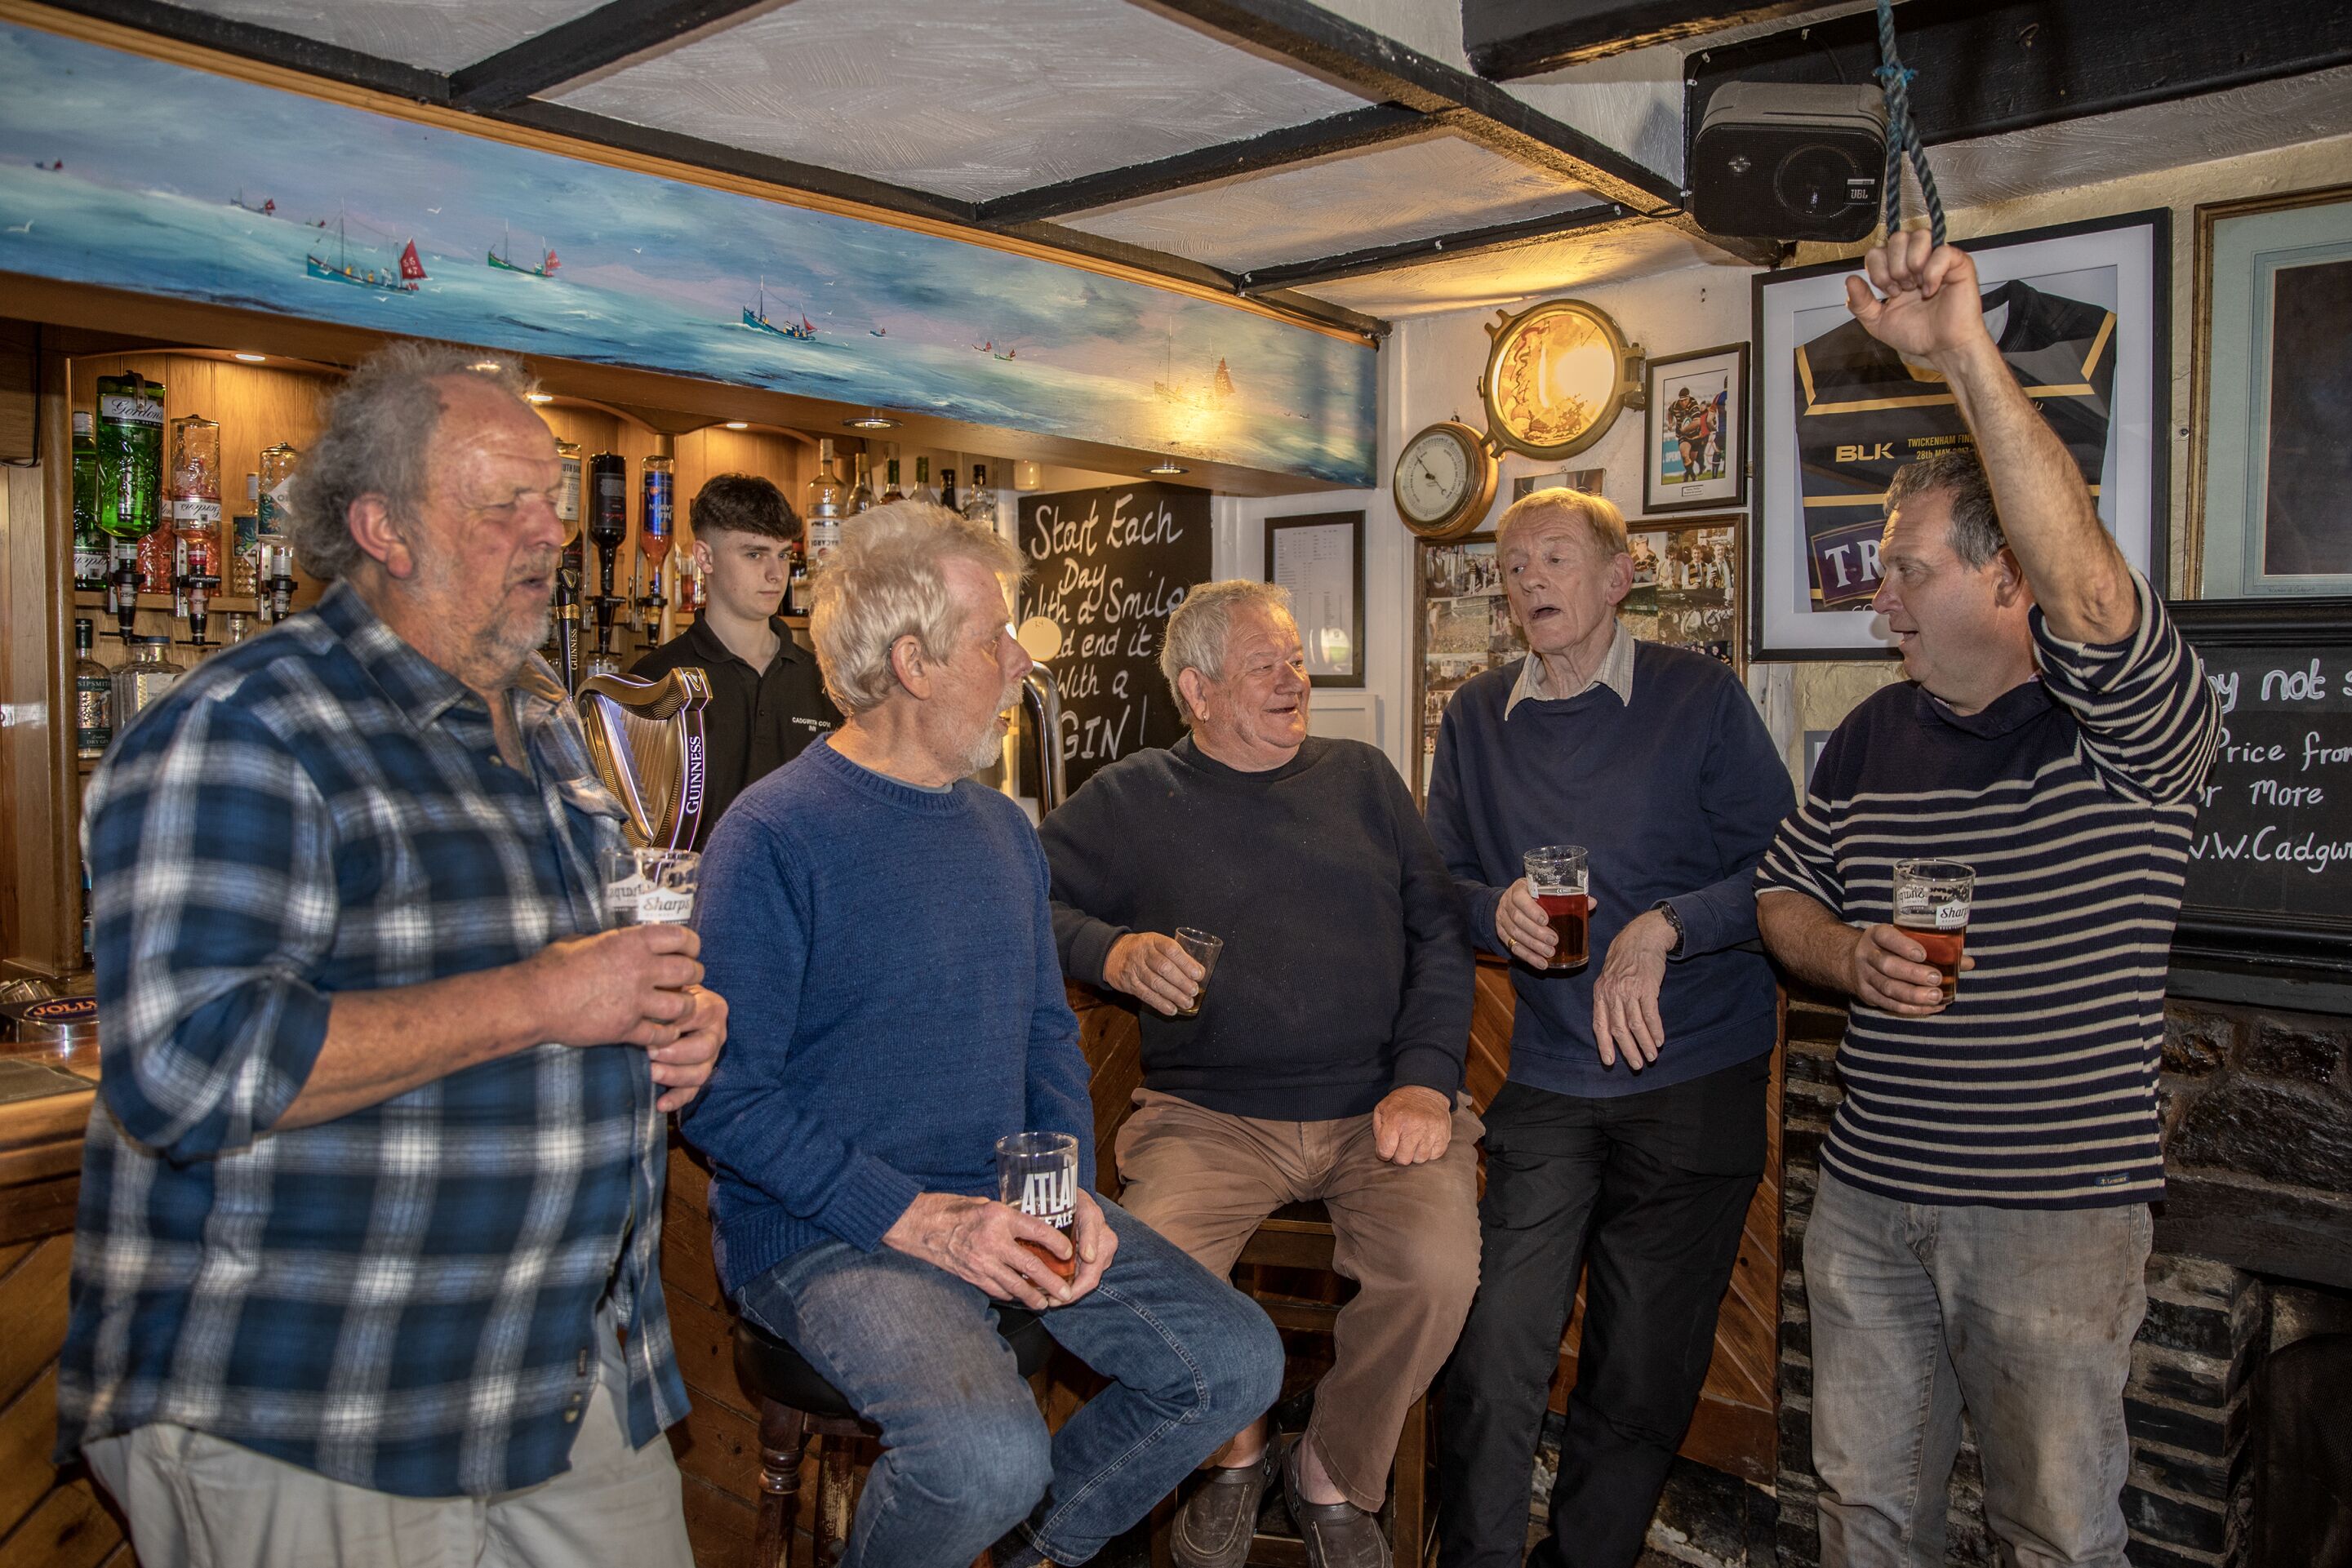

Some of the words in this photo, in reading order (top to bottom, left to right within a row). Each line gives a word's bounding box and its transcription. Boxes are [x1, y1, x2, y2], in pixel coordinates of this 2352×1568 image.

[1851, 189, 1869, 199] JBL
[1836, 442, 1895, 463] BLK
[1907, 434, 1956, 448] TWICKENHAM
[1916, 450, 1933, 460] 28th
[180, 502, 220, 517] Gordon's
[1030, 499, 1099, 561] Start
[1106, 493, 1184, 549] Each
[1058, 557, 1107, 611] Day
[1081, 627, 1121, 659] end
[1127, 622, 1152, 657] it
[1057, 663, 1100, 700] With
[2261, 658, 2326, 702] not
[792, 717, 817, 726] CADGWITH
[1061, 704, 1131, 761] GIN
[686, 735, 702, 815] GUINNESS
[2249, 780, 2324, 807] More
[1055, 1210, 1074, 1228] ALE
